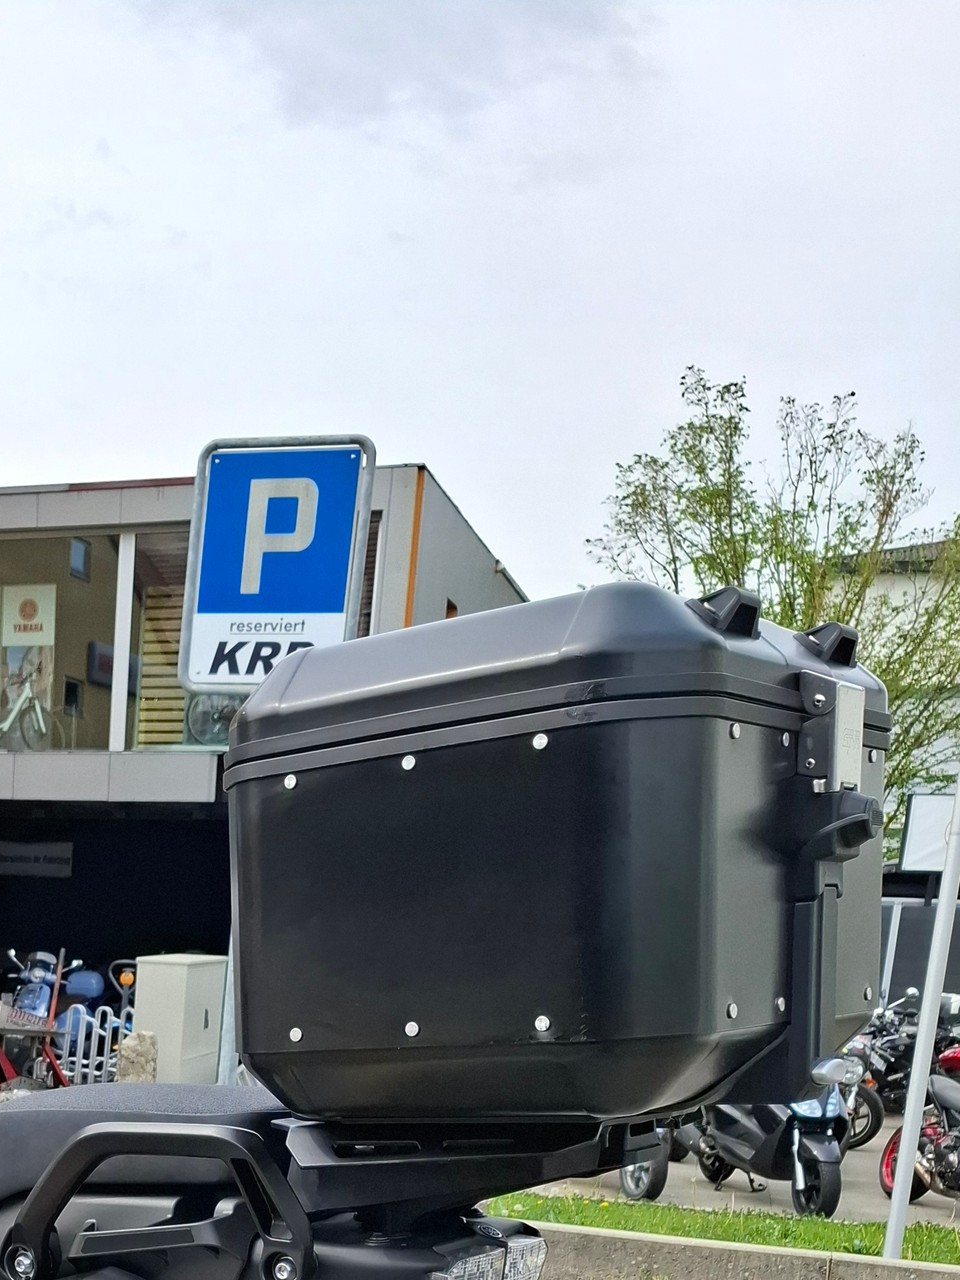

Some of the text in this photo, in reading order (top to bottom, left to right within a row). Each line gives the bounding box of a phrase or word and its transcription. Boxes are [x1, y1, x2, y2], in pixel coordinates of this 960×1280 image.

[240, 477, 319, 595] P
[13, 623, 44, 633] YAMAHA
[229, 617, 305, 633] reserviert
